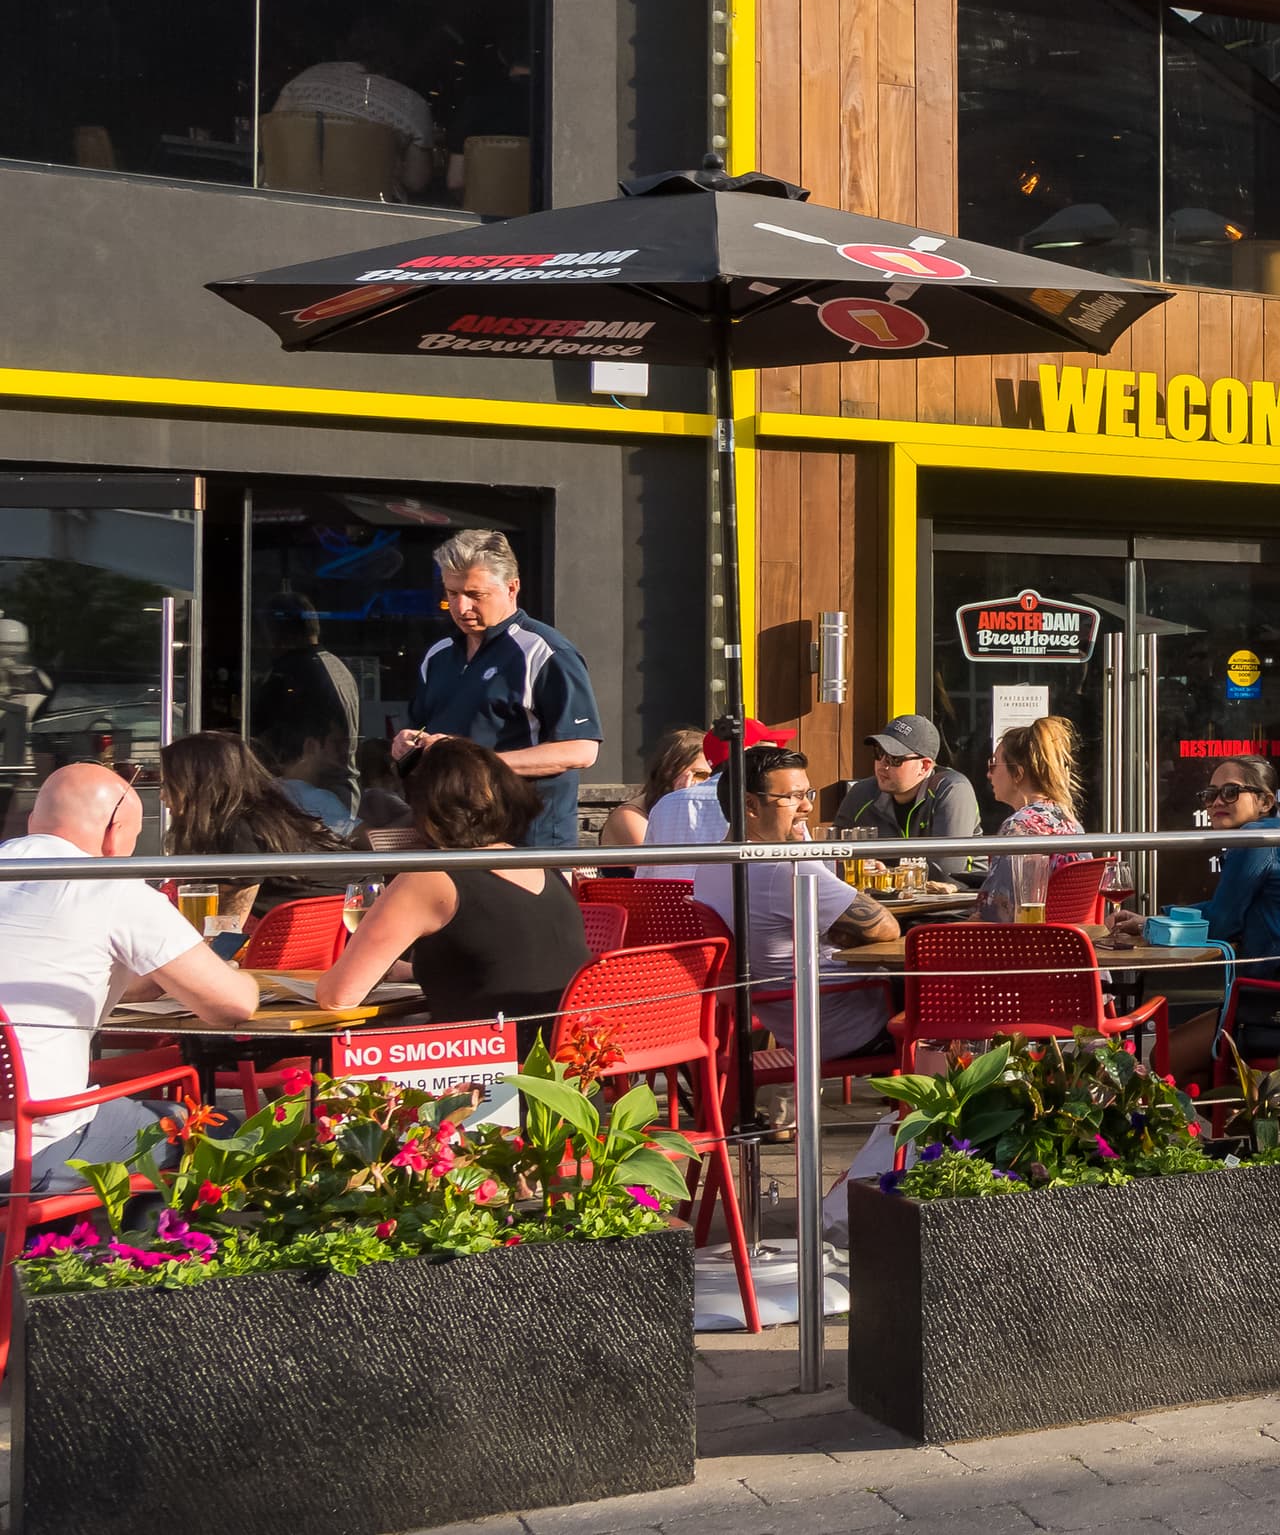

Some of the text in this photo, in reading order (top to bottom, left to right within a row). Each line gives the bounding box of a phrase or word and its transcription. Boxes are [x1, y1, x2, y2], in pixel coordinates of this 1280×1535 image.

[397, 249, 640, 268] AMSTERDAM
[355, 267, 622, 281] BrewHouse
[448, 314, 656, 340] AMSTERDAM
[417, 333, 644, 357] BrewHouse
[978, 611, 1080, 632] AMSTERDAM
[977, 629, 1080, 647] BrewHouse
[741, 845, 851, 858] NO BICYCLES
[344, 1036, 506, 1067] NO SMOKING
